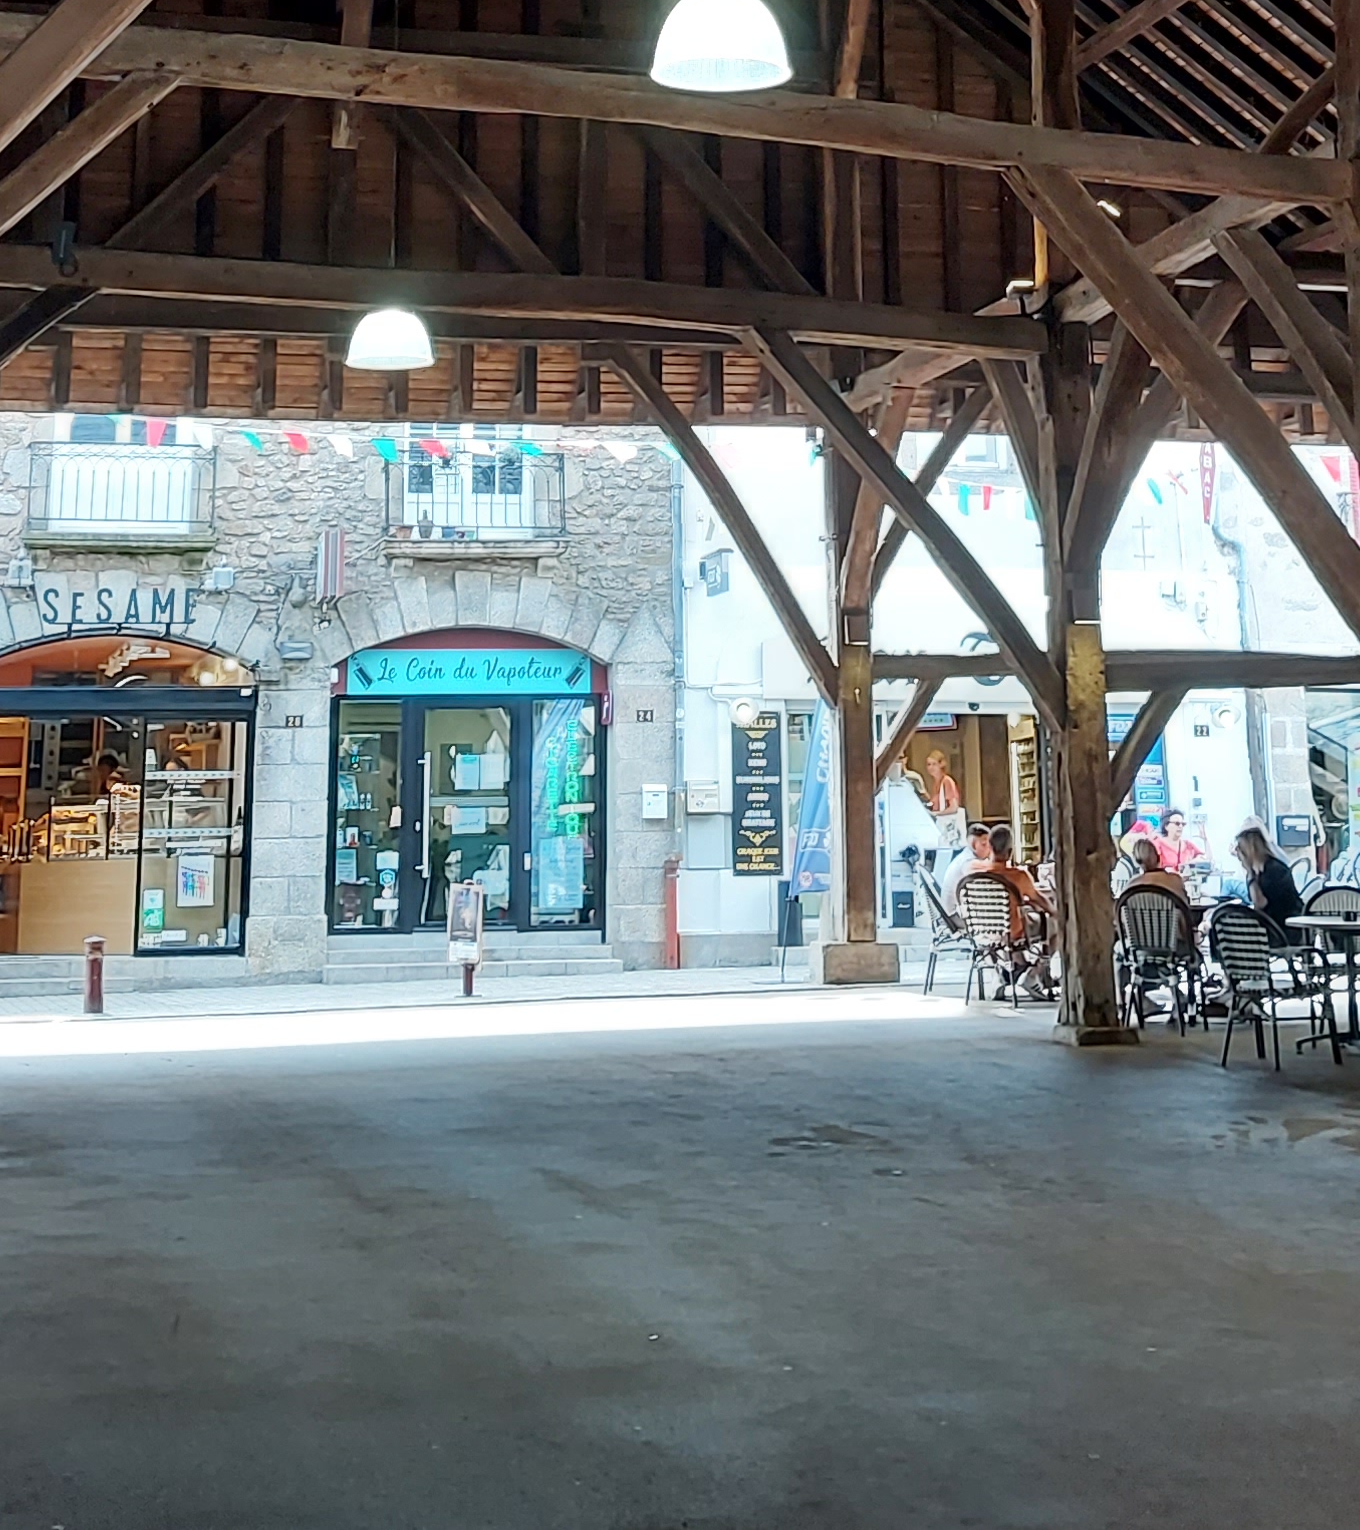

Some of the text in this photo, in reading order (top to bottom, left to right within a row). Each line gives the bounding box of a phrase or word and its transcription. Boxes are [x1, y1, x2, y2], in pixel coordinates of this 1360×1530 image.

[1203, 442, 1213, 498] ABAC
[42, 587, 200, 624] SESAME
[377, 656, 562, 686] Le Coin du Vapoteur
[638, 710, 652, 722] 24
[1196, 724, 1208, 737] 22
